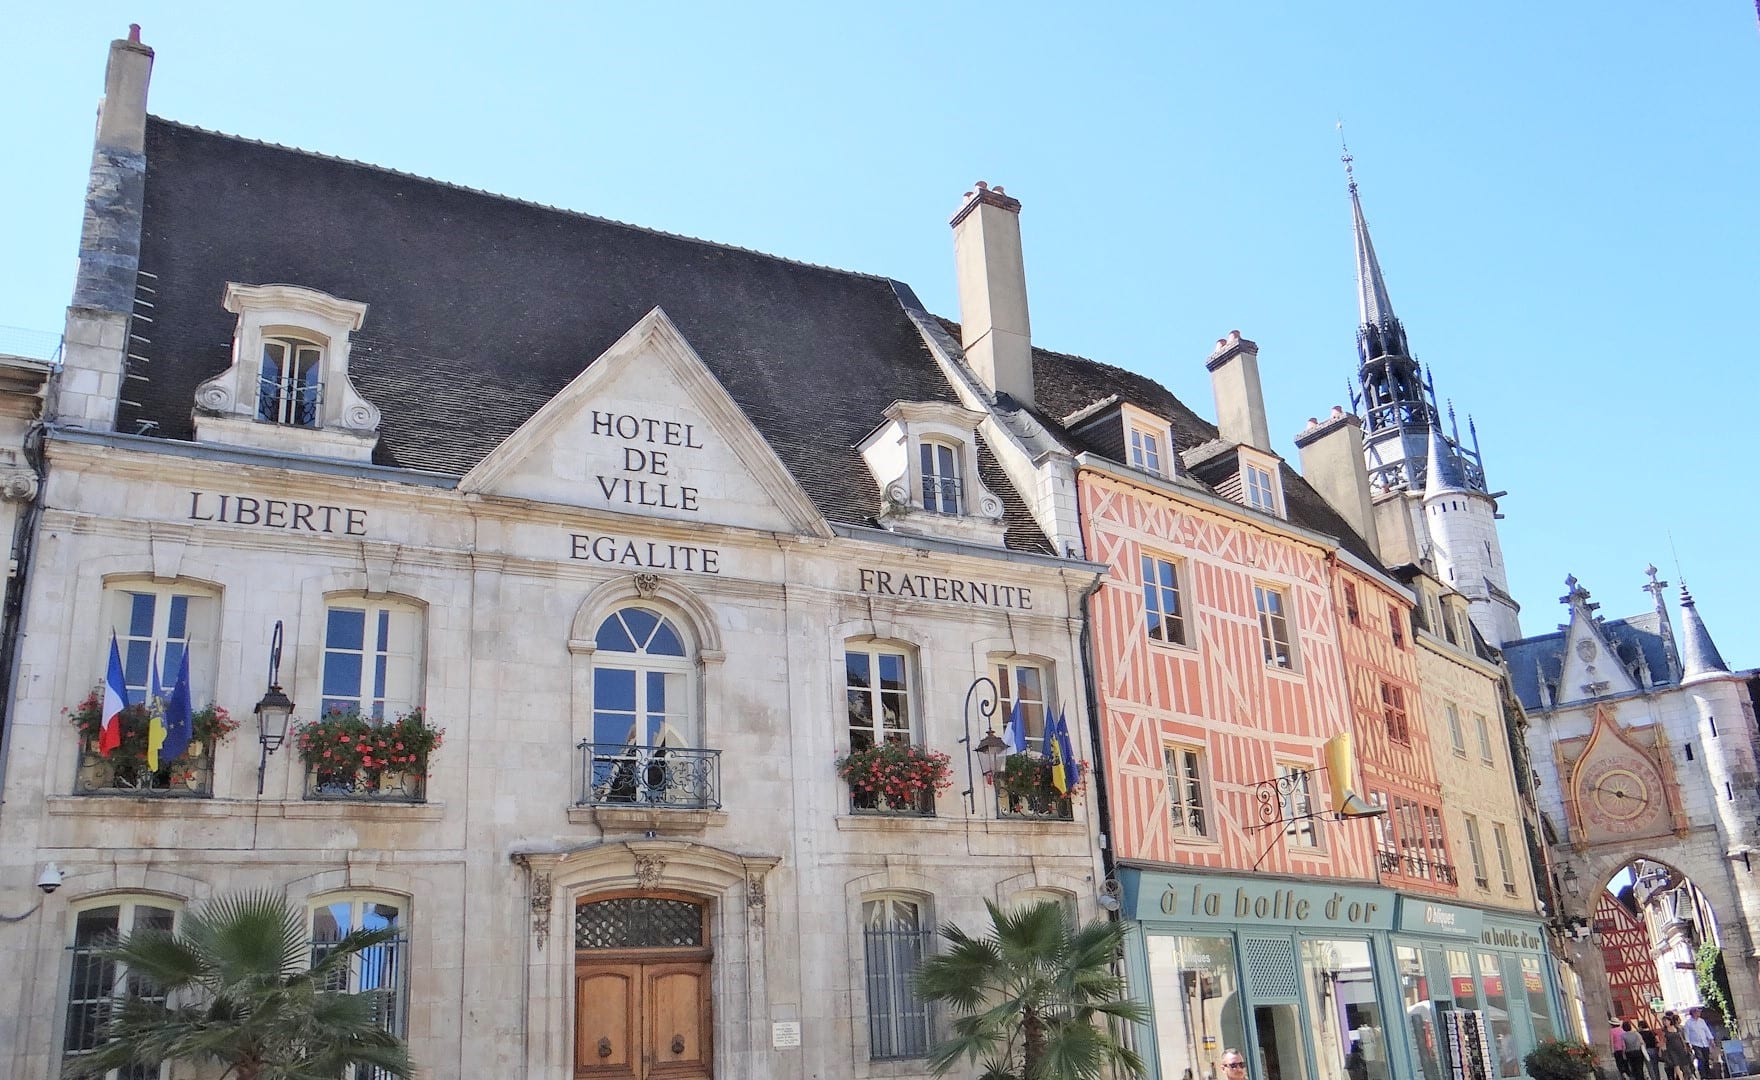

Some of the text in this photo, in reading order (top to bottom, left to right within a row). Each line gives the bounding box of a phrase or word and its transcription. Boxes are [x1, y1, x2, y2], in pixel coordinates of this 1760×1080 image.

[591, 410, 704, 449] HOTEL
[623, 447, 669, 476] DE
[596, 475, 699, 511] VILLE
[188, 491, 368, 536] LIBERTE
[569, 533, 720, 574] EGALITE
[858, 568, 1033, 610] FRATERNITE
[1160, 883, 1177, 915] à
[1192, 884, 1221, 916] la
[1325, 891, 1377, 923] d'or
